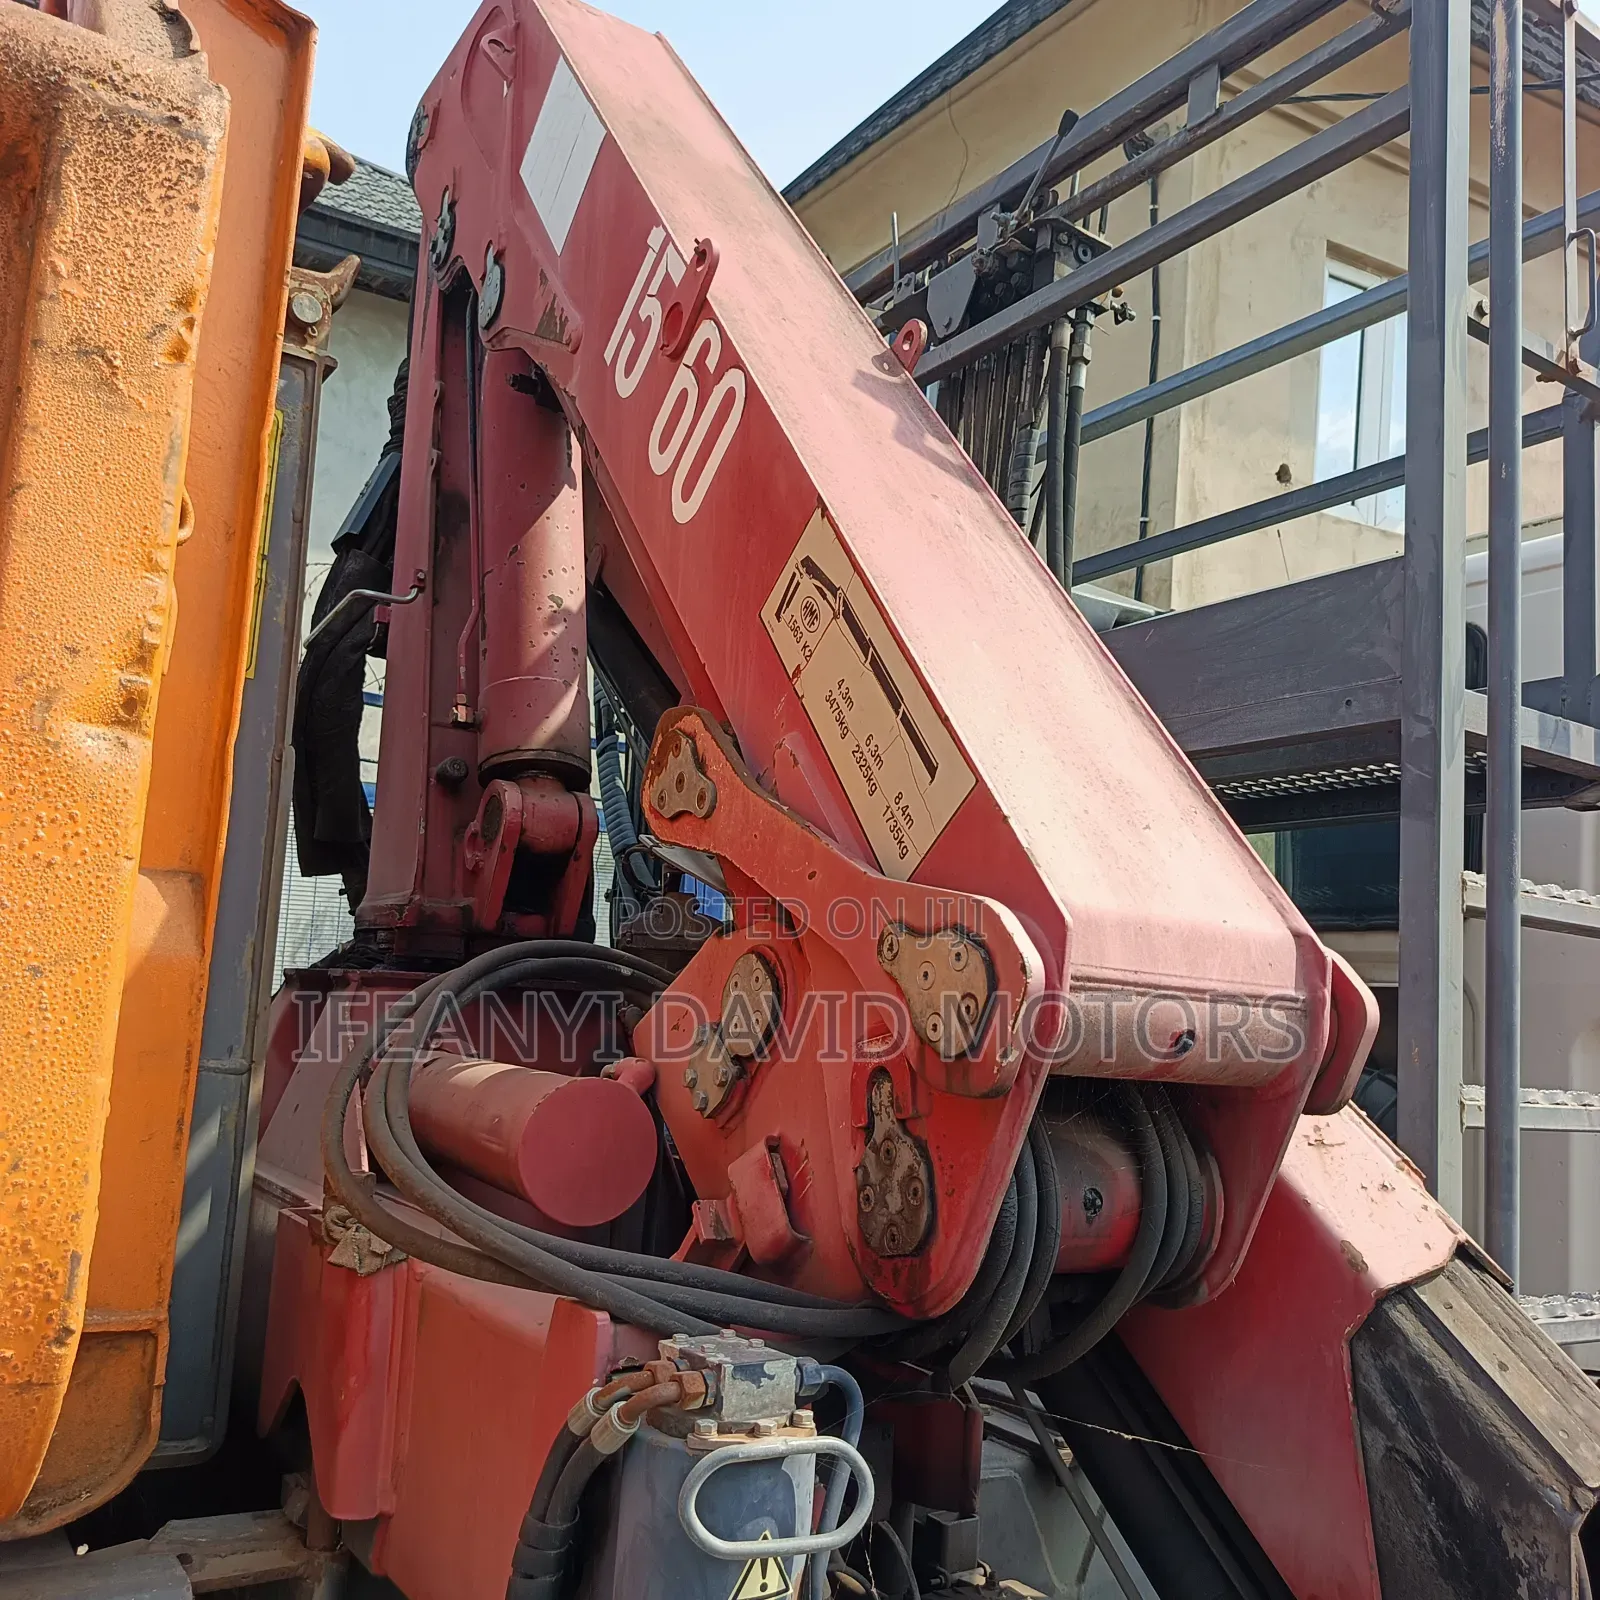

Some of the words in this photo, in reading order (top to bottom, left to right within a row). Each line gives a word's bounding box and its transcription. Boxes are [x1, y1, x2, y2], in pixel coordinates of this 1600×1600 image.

[788, 613, 804, 644] 1563
[802, 600, 819, 628] HMF
[837, 678, 855, 712] 4,3m
[825, 689, 850, 740] 3475kg
[851, 744, 878, 797] 2325kg
[865, 733, 885, 771] 6,3m
[894, 791, 915, 830] 8,4m
[881, 804, 910, 860] 1735kg
